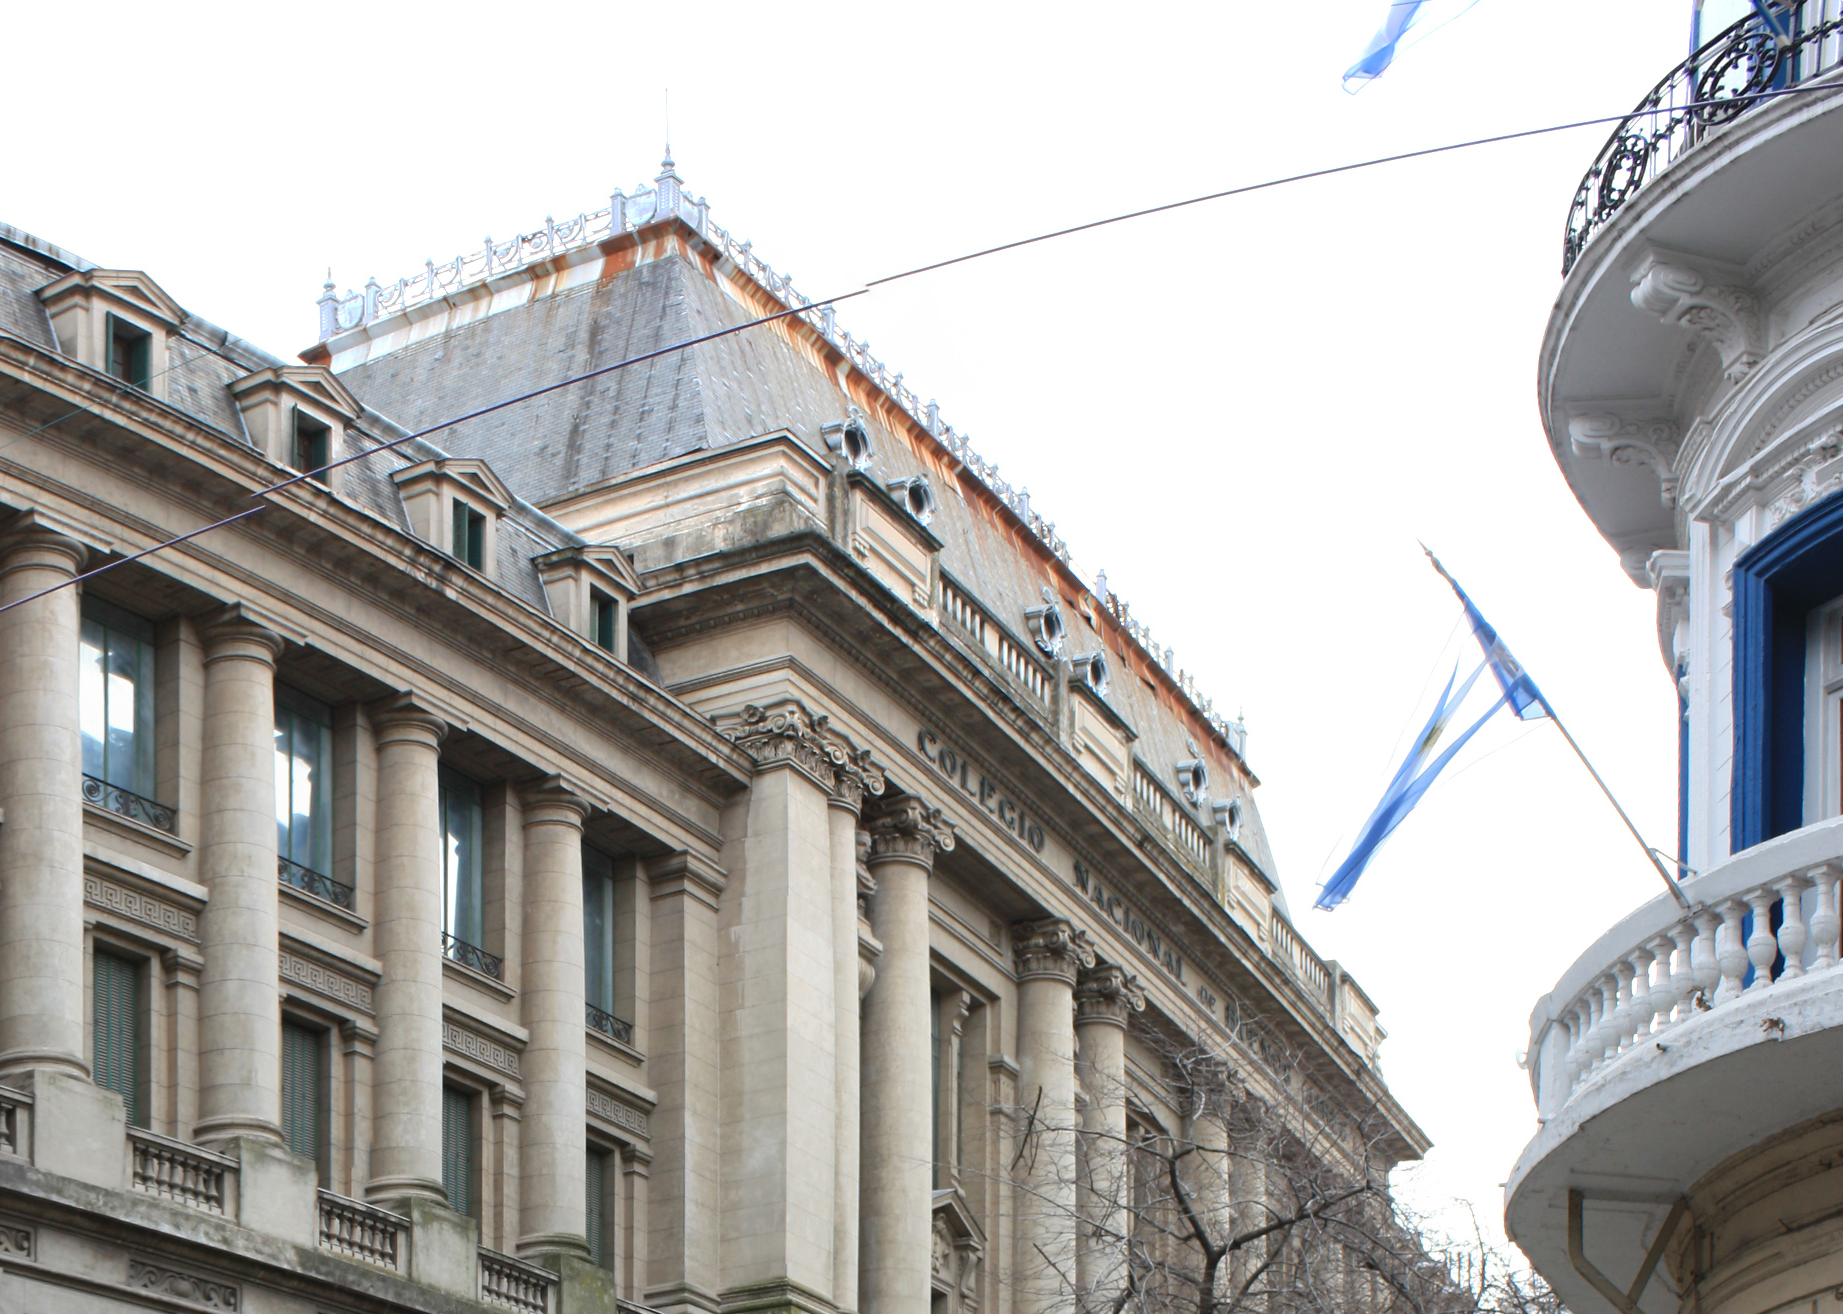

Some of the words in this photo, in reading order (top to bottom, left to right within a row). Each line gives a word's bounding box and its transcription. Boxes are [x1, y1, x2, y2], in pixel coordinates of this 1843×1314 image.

[918, 728, 1045, 853] COLEGIO
[1073, 860, 1187, 986] NACIONAL
[1199, 984, 1216, 1014] DE
